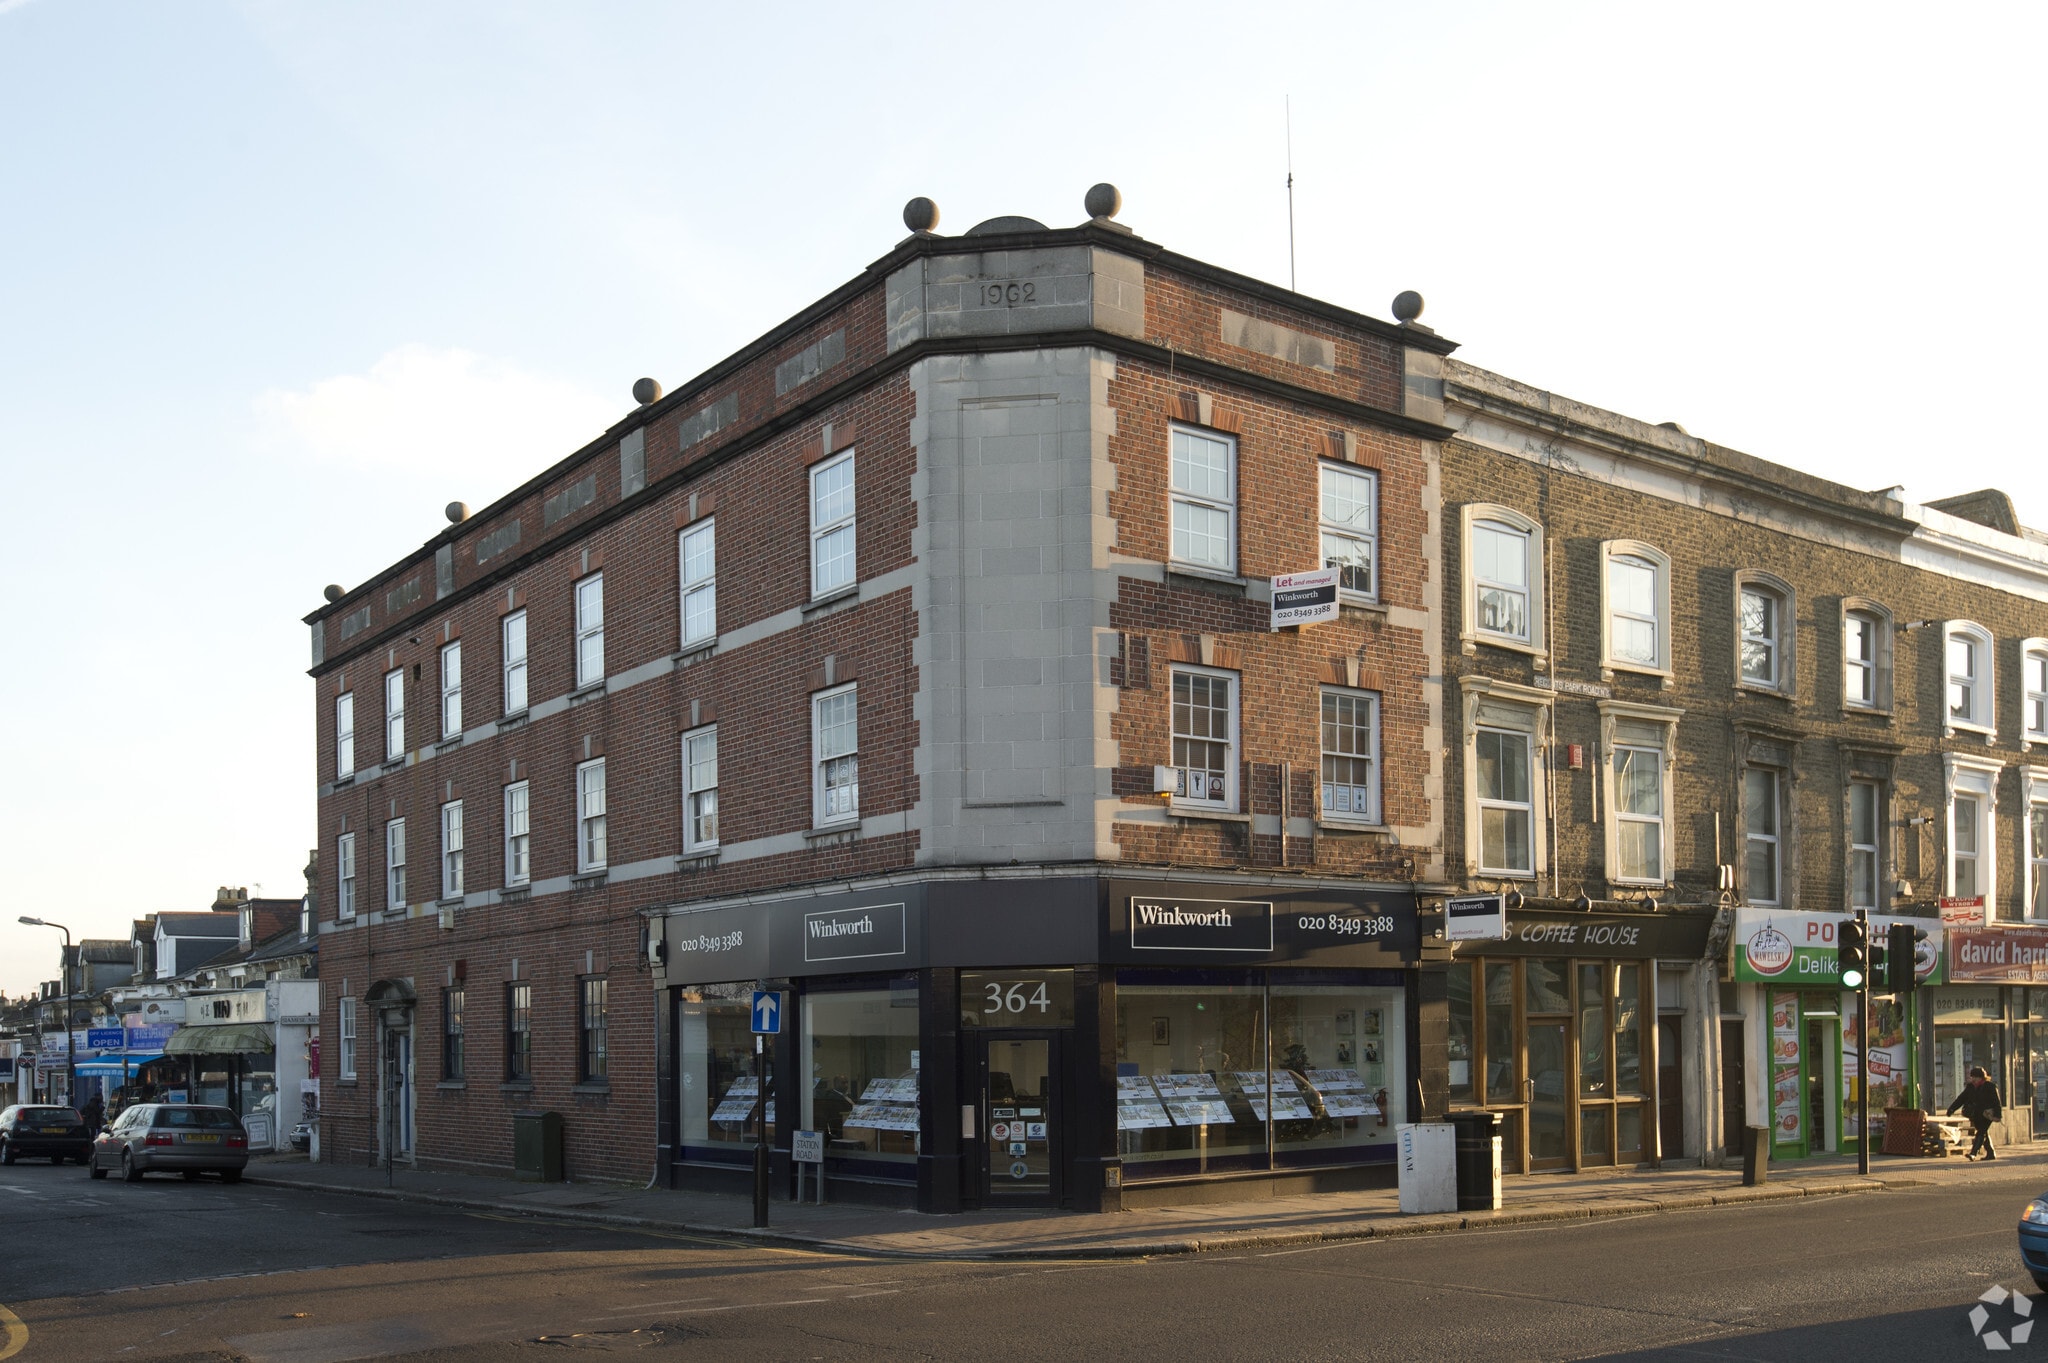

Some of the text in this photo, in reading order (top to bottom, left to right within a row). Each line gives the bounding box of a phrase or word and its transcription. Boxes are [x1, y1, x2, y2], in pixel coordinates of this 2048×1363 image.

[1276, 577, 1293, 588] Let
[1305, 576, 1332, 585] managed
[1277, 590, 1319, 602] Winkworth
[1277, 604, 1331, 619] 020 8349 3388
[1535, 679, 1563, 690] REGTS
[1564, 682, 1581, 693] PARK
[1582, 685, 1600, 695] ROAD
[1451, 902, 1485, 911] Winkworth
[1138, 904, 1232, 927] Winkworth
[809, 915, 874, 938] Winkworth
[1299, 914, 1394, 936] 020 8349 3388
[681, 930, 743, 952] 020 8349 3388
[1521, 924, 1578, 943] COFFEE
[1583, 925, 1641, 946] HOUSE
[1754, 951, 1785, 963] WAWELSKI
[1960, 939, 2005, 964] david
[1951, 971, 1975, 979] LETTINGS
[2007, 970, 2030, 979] ESTATE
[984, 982, 1051, 1014] 364
[1936, 999, 1995, 1009] 020 8346 9122
[93, 1039, 120, 1047] OPEN
[1871, 1062, 1890, 1073] POLAND
[796, 1140, 819, 1150] STATION
[1404, 1132, 1412, 1153] CITY
[796, 1150, 813, 1160] ROAD
